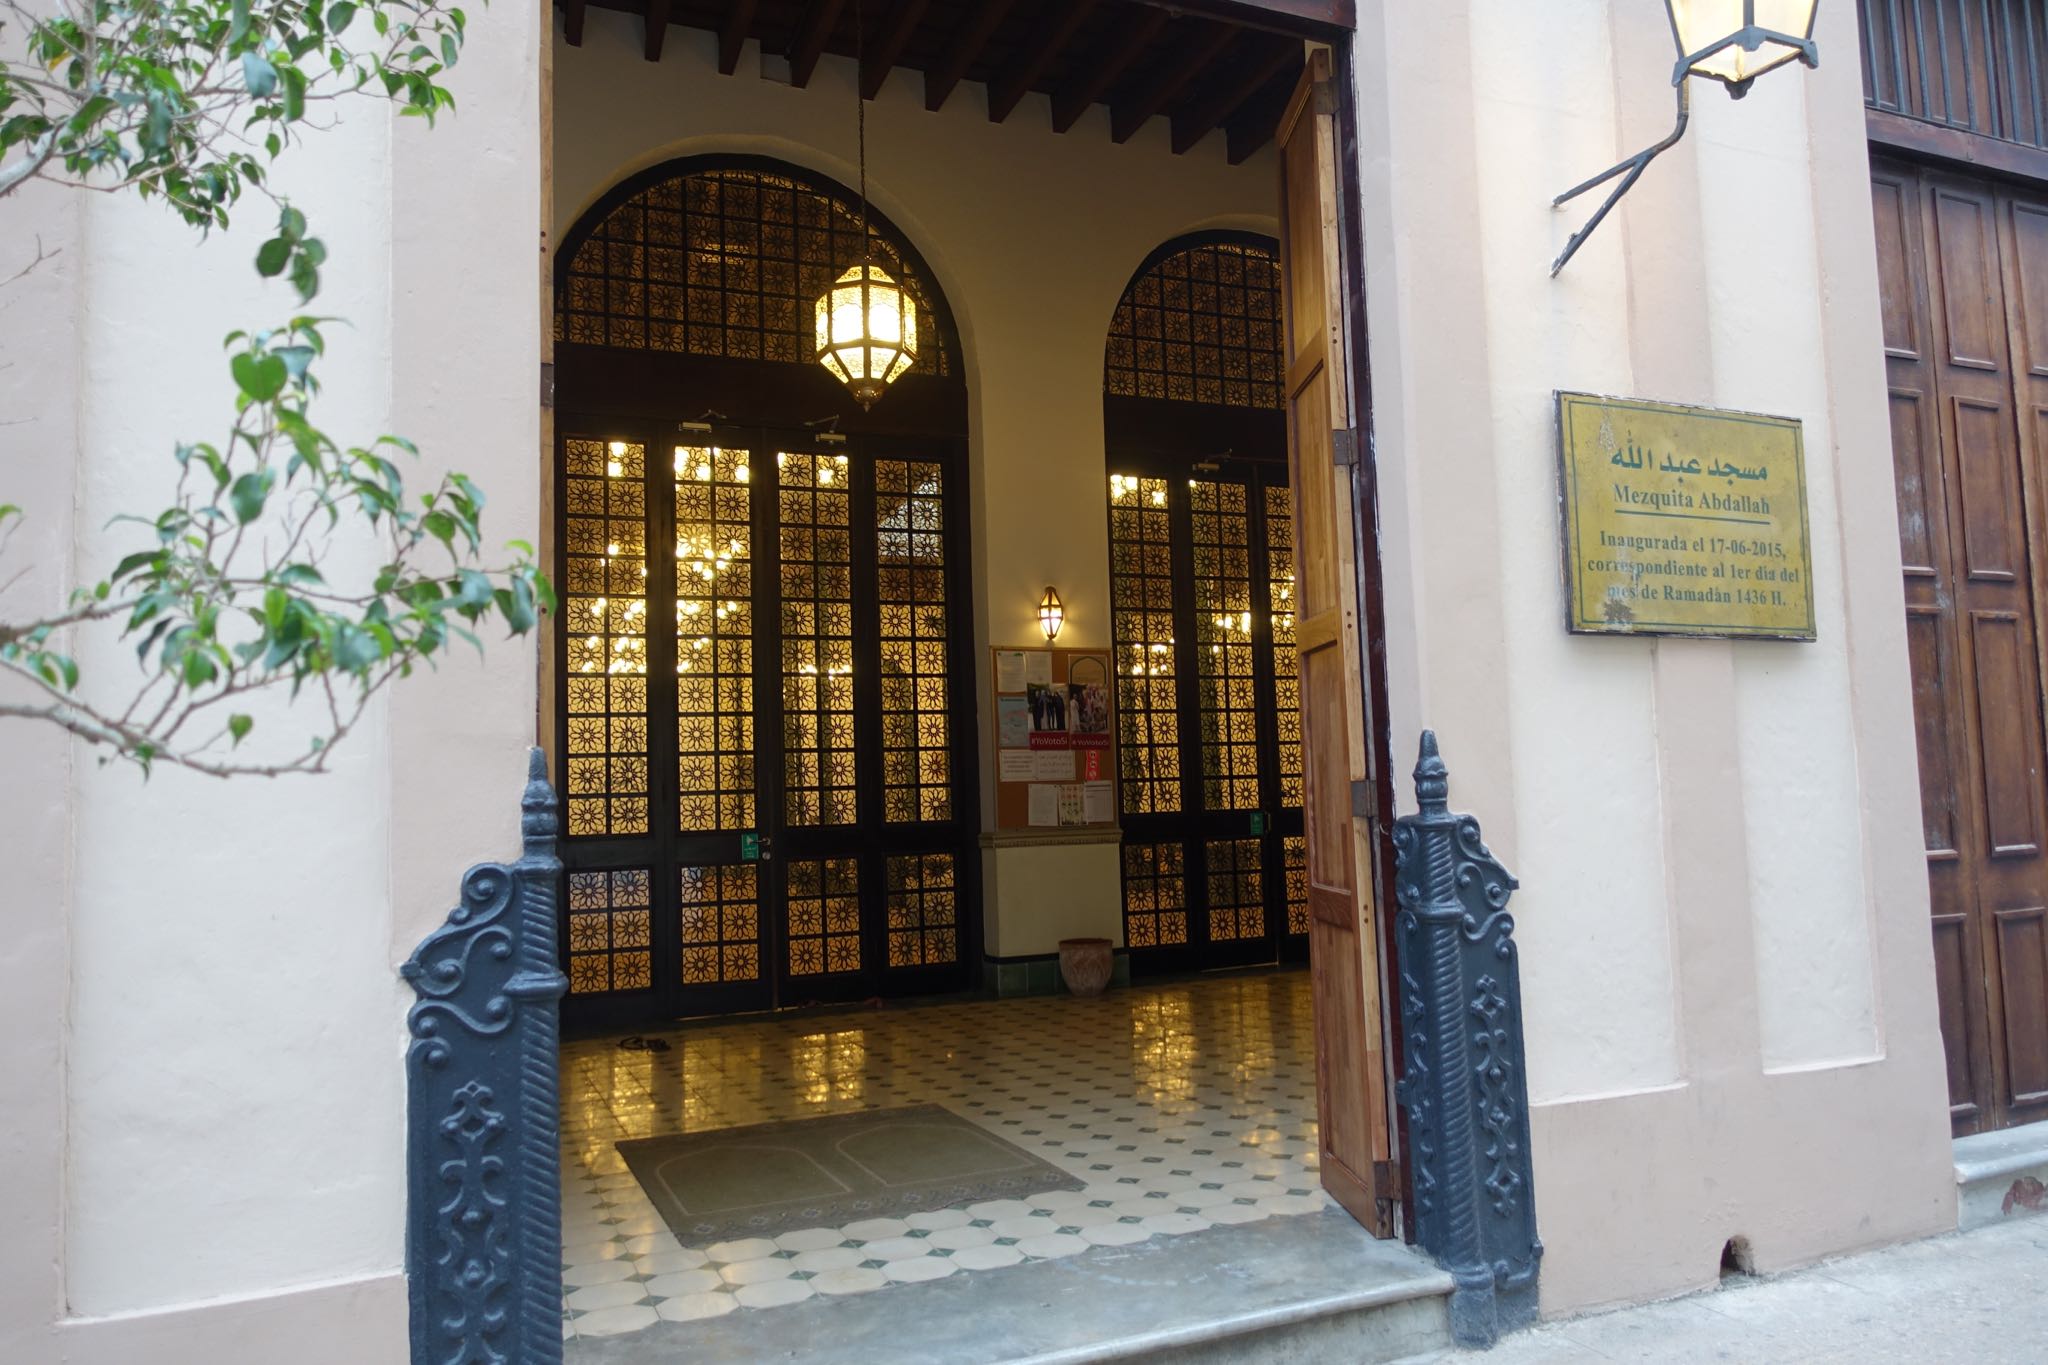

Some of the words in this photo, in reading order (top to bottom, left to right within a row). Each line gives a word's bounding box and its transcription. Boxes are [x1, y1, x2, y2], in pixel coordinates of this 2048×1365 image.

[1660, 453, 1701, 483] عبد
[1707, 458, 1767, 486] مسجد
[1614, 484, 1693, 510] Mezquita
[1699, 492, 1770, 514] Abdallah
[1600, 531, 1687, 552] Inaugurada
[1693, 538, 1704, 551] el
[1710, 538, 1786, 560] 17-06-2015,
[1588, 559, 1707, 580] correspondiente
[1712, 563, 1725, 578] al
[1730, 565, 1750, 579] 1er
[1780, 568, 1799, 583] del
[1607, 586, 1636, 598] mes
[1642, 584, 1658, 599] de
[1737, 589, 1767, 605] 1436
